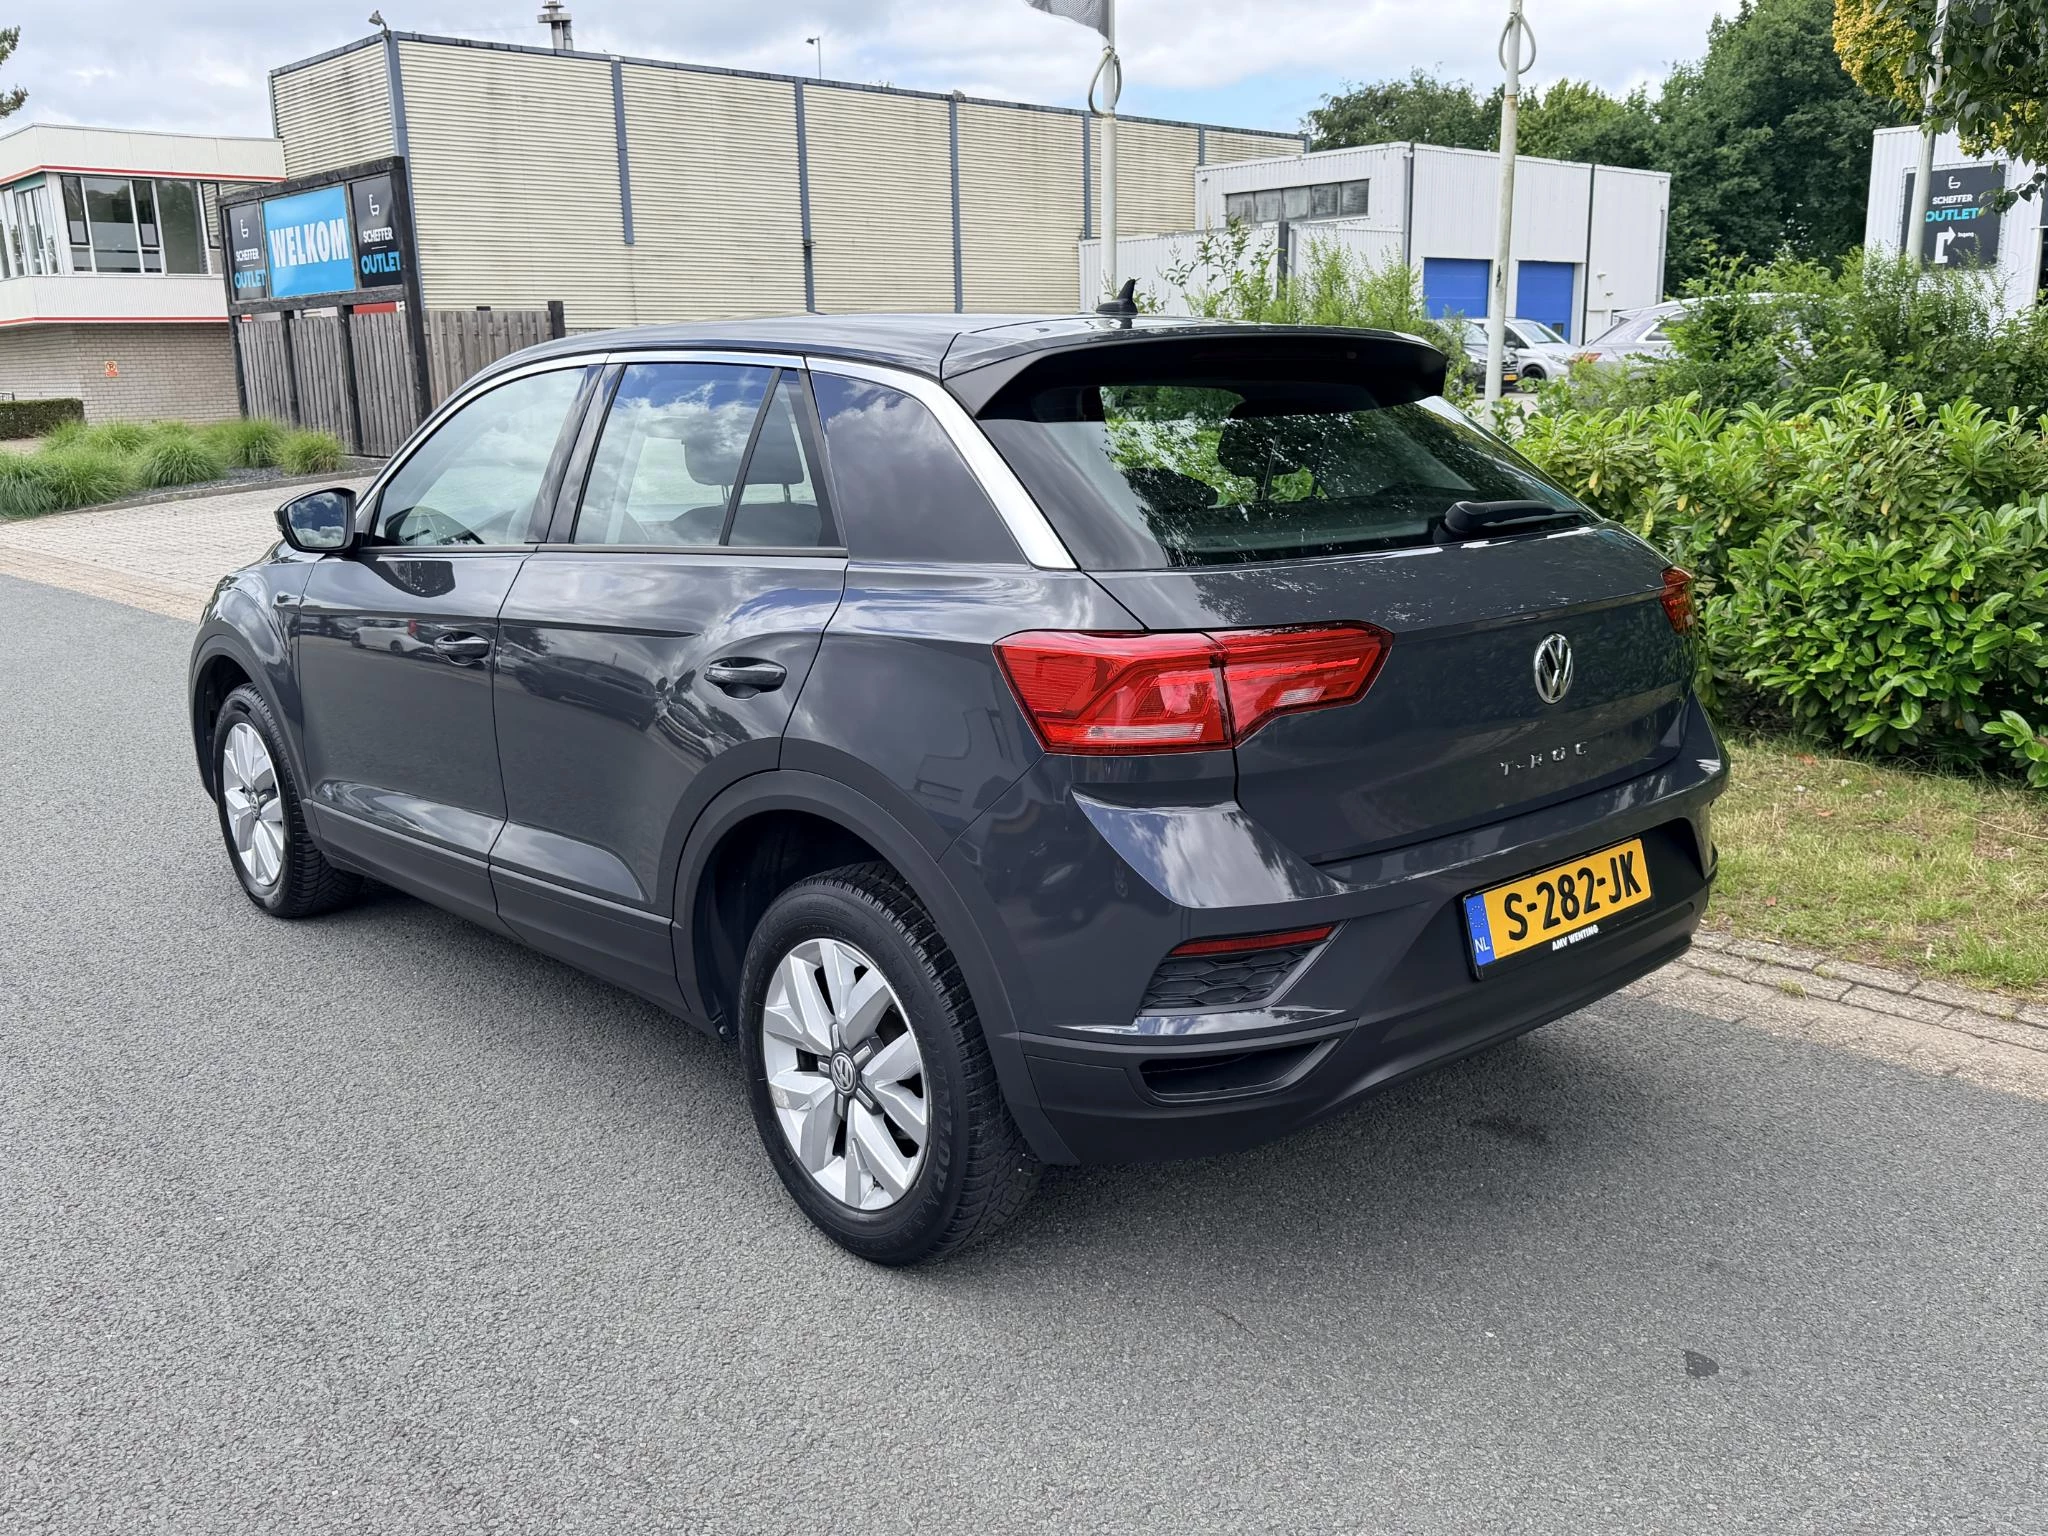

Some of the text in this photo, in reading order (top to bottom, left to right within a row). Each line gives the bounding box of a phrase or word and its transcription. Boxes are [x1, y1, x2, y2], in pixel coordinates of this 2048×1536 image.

[1932, 193, 1973, 205] SCHEFFER
[1925, 207, 1979, 222] OUTLET
[269, 218, 349, 268] WELKOM
[363, 226, 393, 243] SCHEFFER
[235, 247, 260, 262] SCHEFFER
[361, 251, 401, 275] OUTLET
[234, 269, 267, 289] OUTLET
[1500, 741, 1588, 776] T-ROC
[1504, 850, 1642, 941] S-282-JK
[1475, 936, 1491, 954] NL
